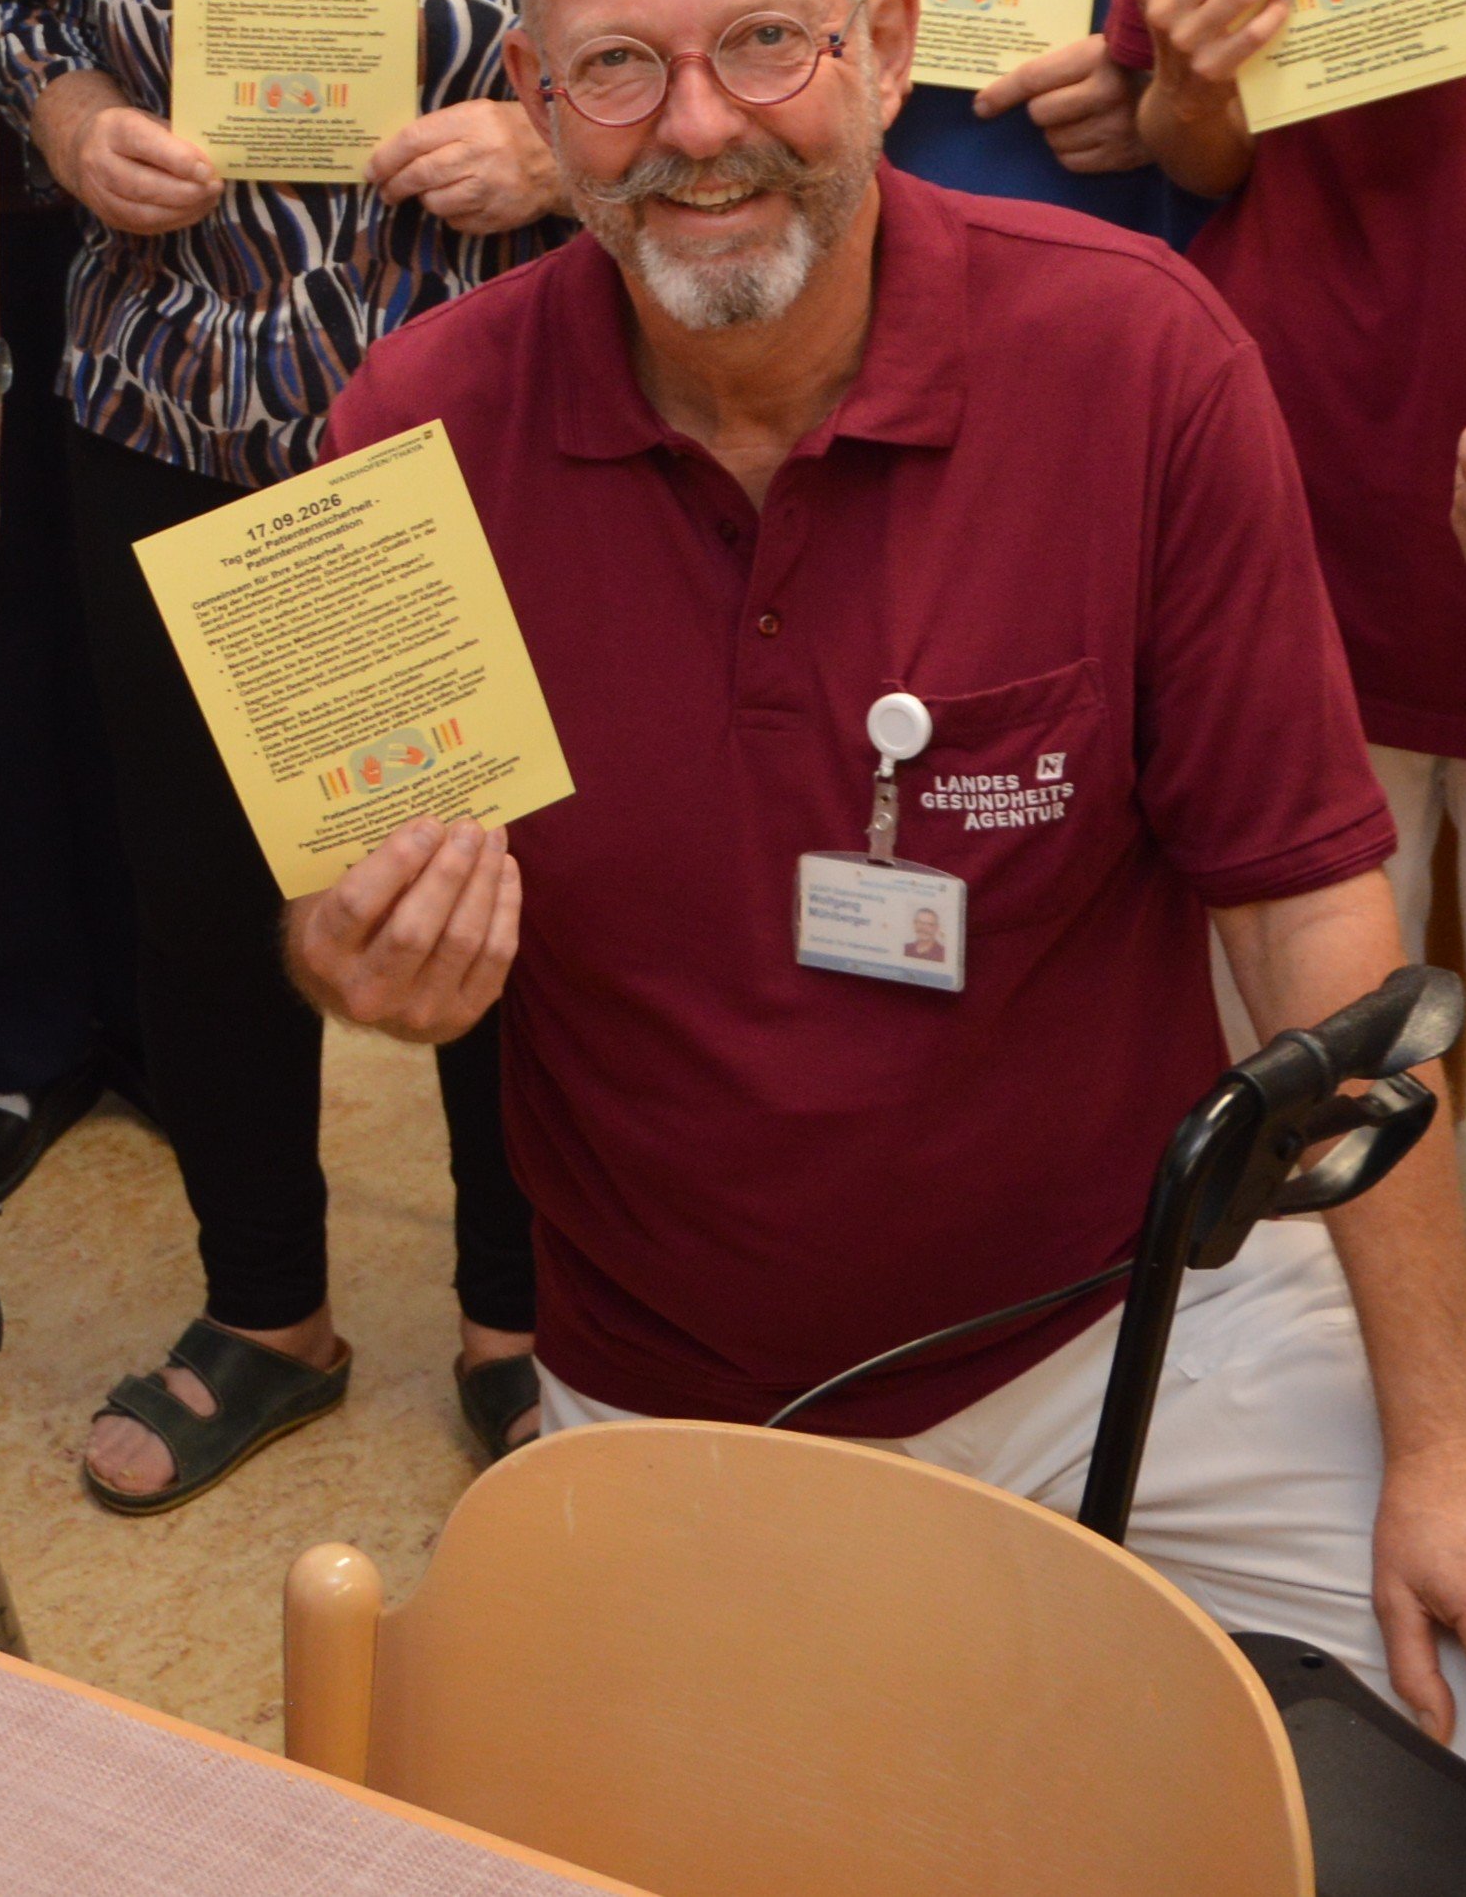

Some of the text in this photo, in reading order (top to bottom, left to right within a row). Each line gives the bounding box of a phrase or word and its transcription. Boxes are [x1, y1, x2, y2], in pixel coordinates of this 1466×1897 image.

[219, 554, 242, 566] Tag
[244, 545, 261, 558] der
[264, 499, 373, 549] Patientensicherheit
[246, 493, 341, 540] 17.09.2026
[245, 518, 363, 571] Patienteninformation
[192, 543, 344, 610] Gemeinsam für Ihre Sicherheit
[920, 782, 1074, 811] GESUNDHEITS
[934, 774, 1020, 793] LANDES
[964, 801, 1065, 831] AGENTUR
